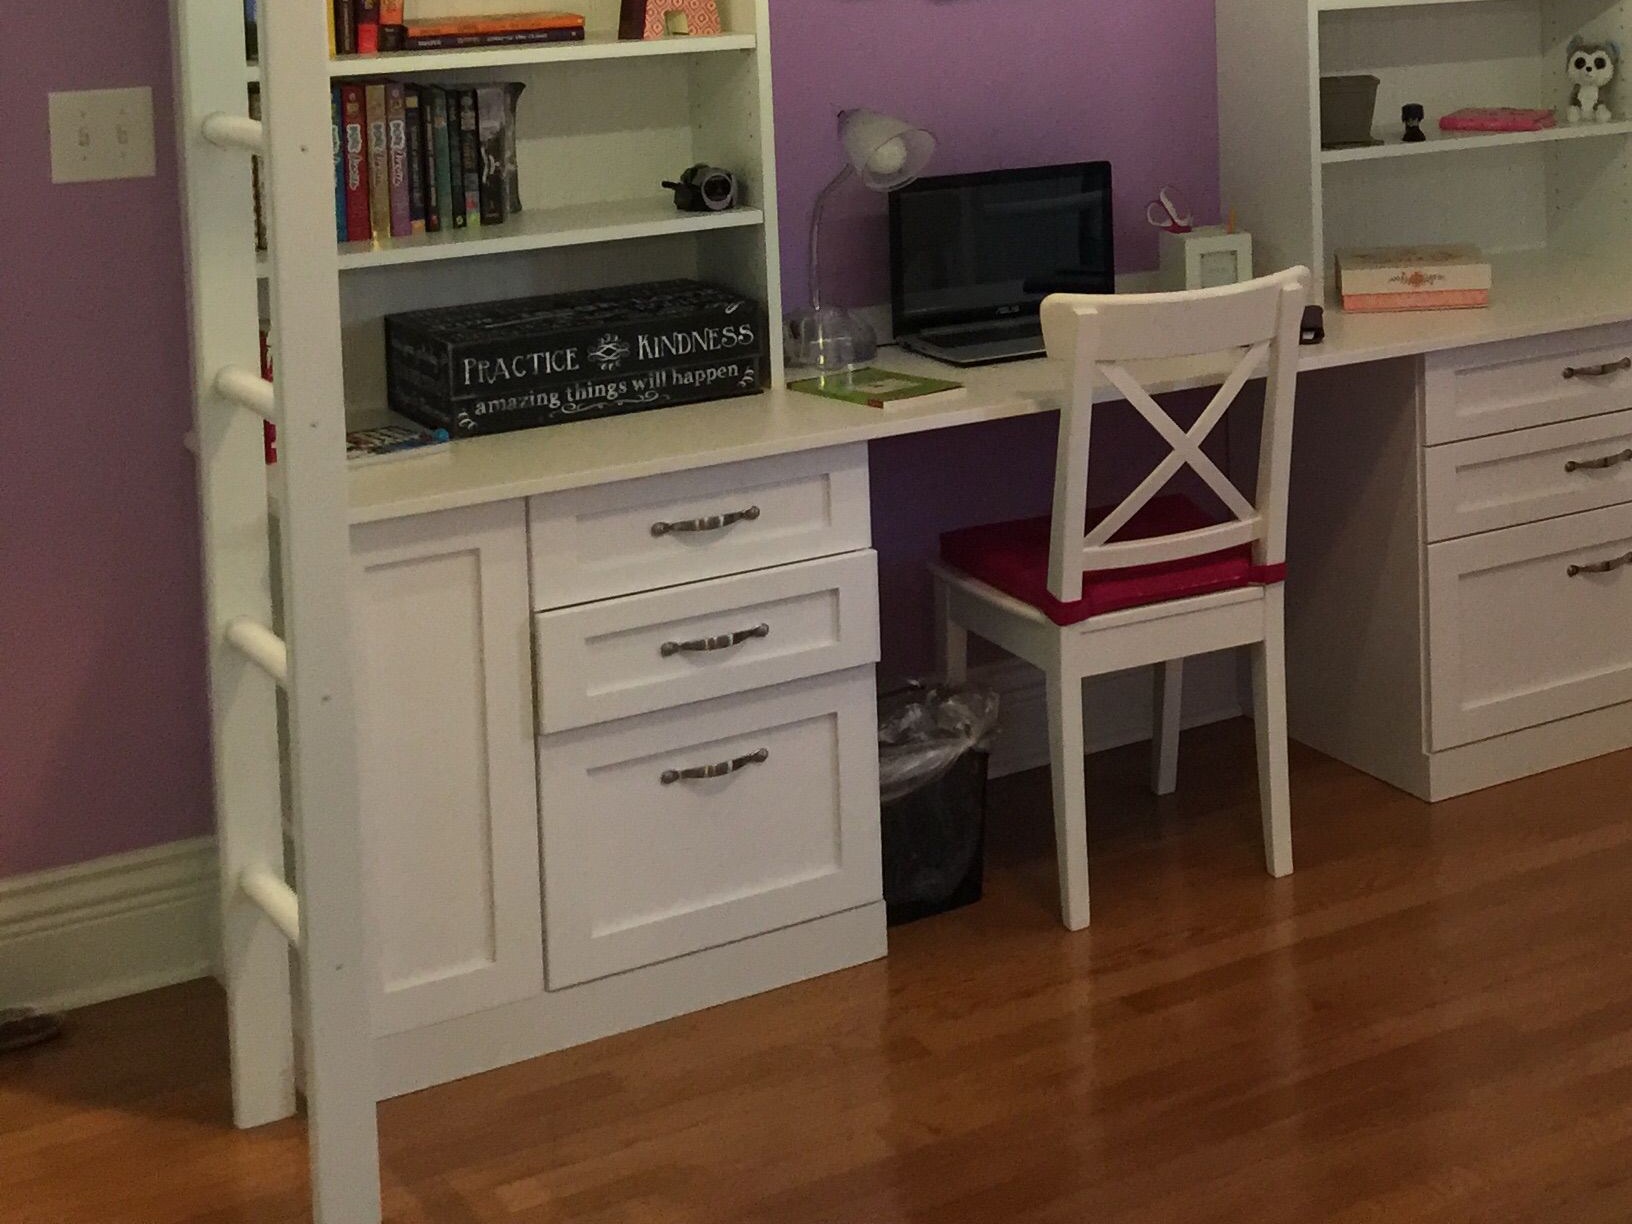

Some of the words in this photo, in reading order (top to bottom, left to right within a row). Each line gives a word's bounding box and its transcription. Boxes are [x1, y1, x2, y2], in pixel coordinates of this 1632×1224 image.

[463, 347, 580, 385] PRACTICE
[637, 323, 755, 361] KINDNESS
[474, 389, 561, 416] amazing
[566, 381, 628, 403] things
[631, 369, 667, 390] will
[671, 363, 739, 388] happen
